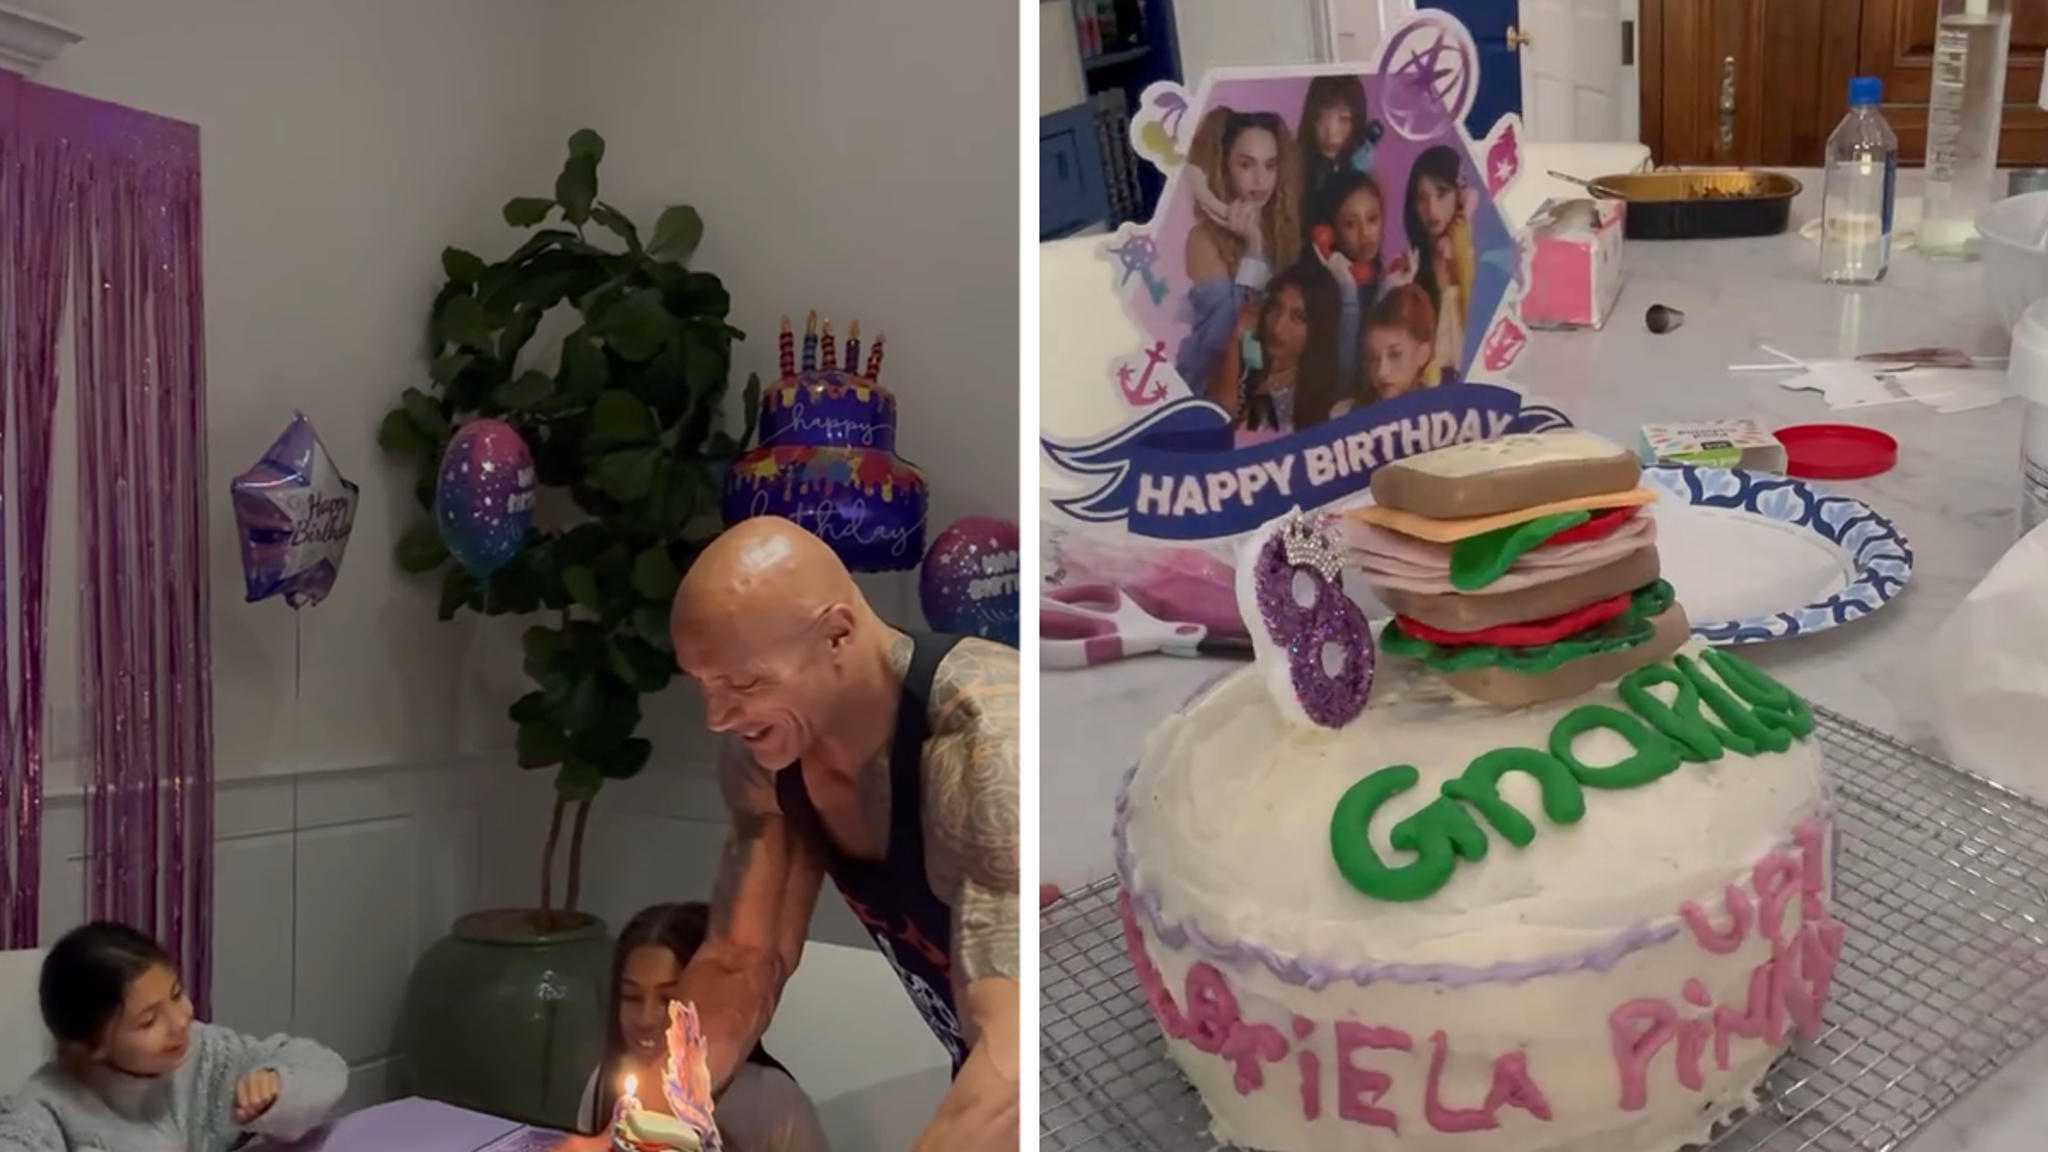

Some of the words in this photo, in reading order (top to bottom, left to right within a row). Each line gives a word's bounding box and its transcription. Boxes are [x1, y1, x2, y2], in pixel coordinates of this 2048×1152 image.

[762, 402, 893, 446] happy
[1135, 454, 1295, 517] HAPPY
[1303, 408, 1514, 487] BIRTHDAY
[307, 492, 348, 520] Happy
[1252, 530, 1375, 729] 8
